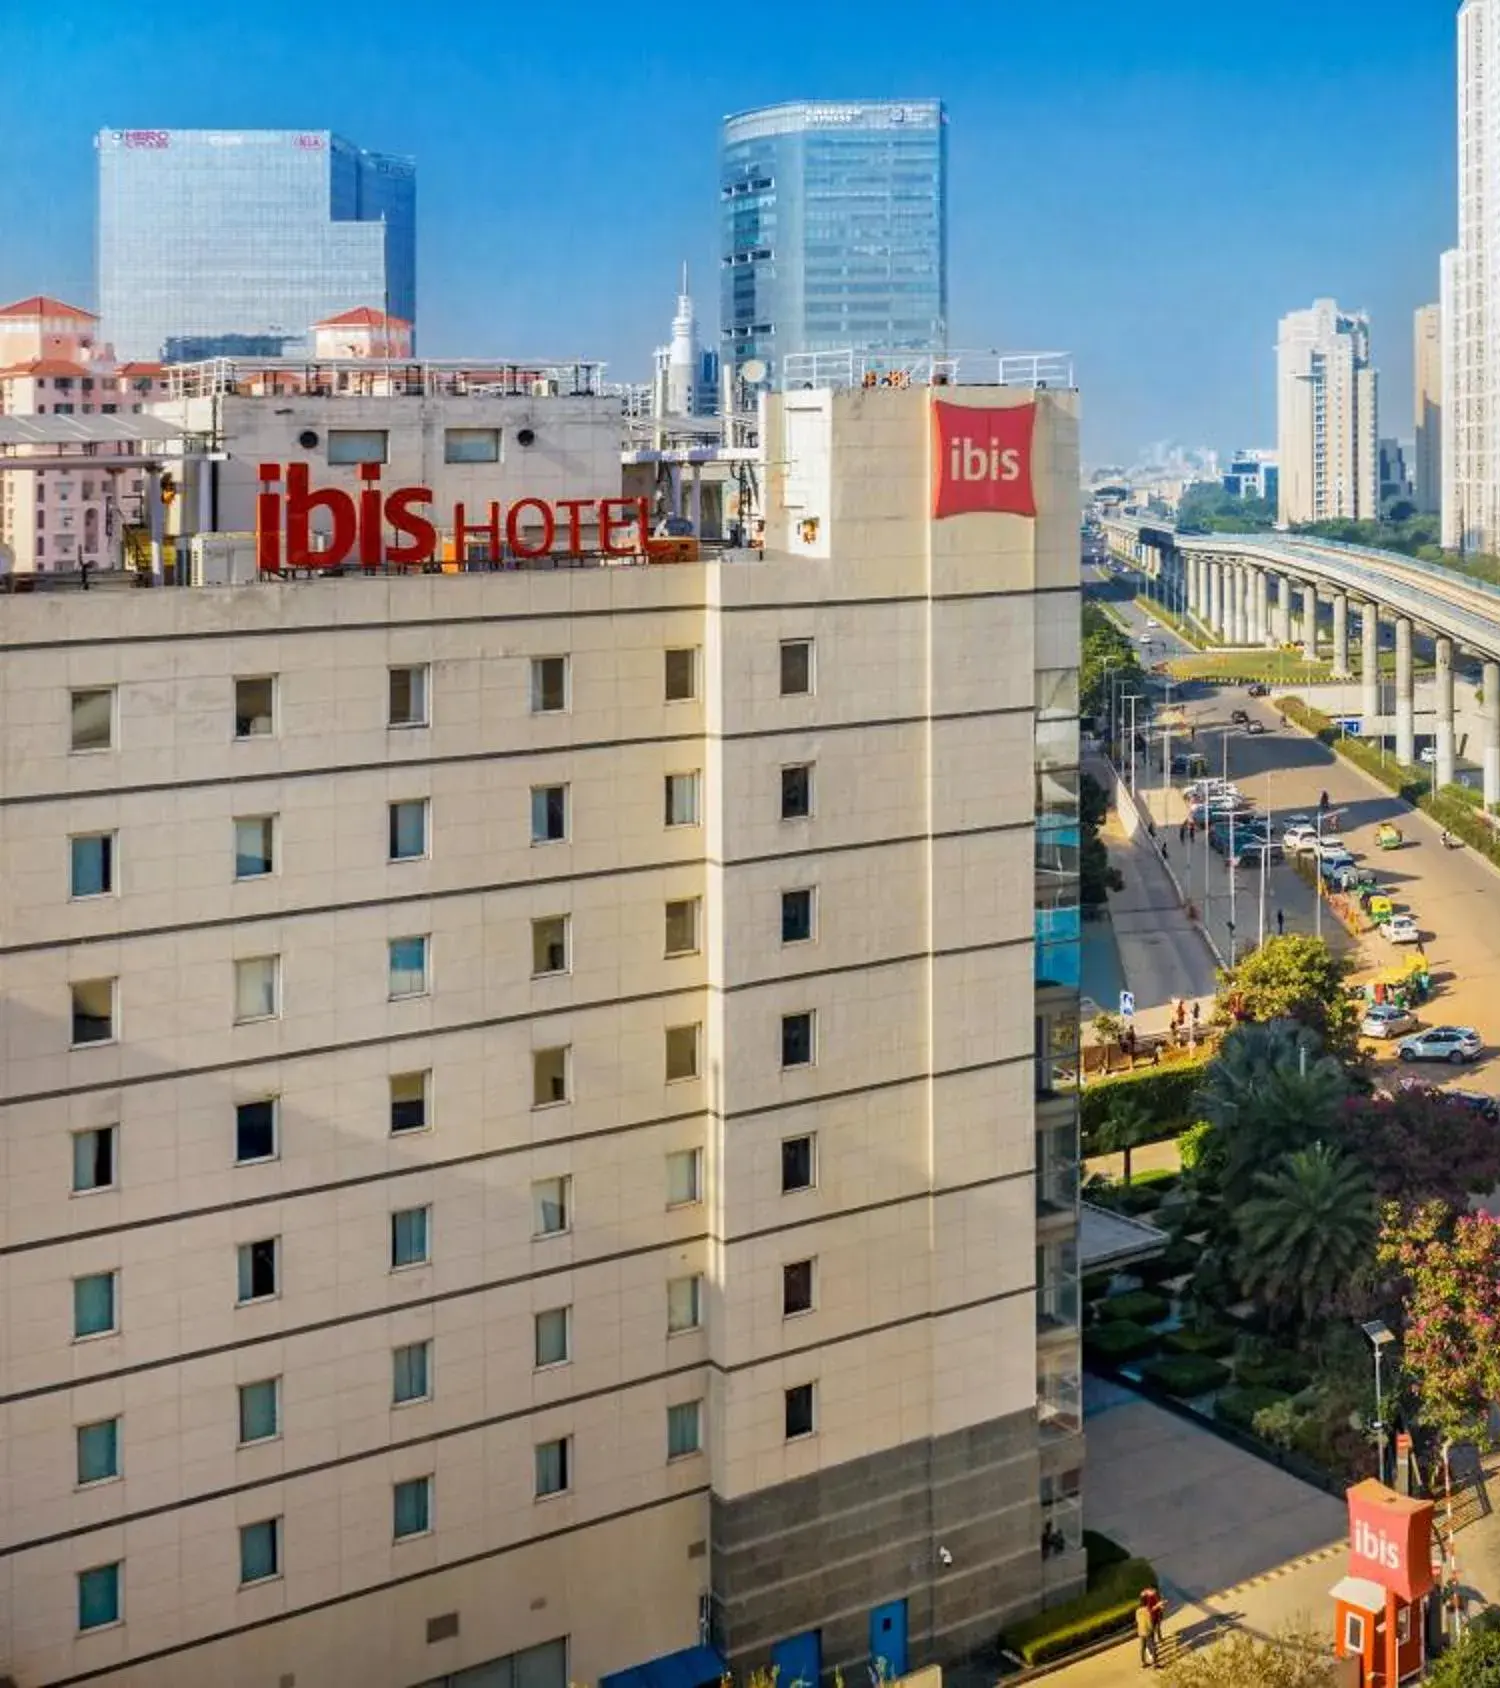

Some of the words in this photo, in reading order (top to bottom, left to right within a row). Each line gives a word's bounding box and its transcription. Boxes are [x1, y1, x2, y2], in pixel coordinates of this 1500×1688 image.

[950, 436, 1021, 482] ibis
[257, 462, 438, 573] ibis
[454, 497, 675, 563] HOTEL
[1355, 1519, 1400, 1570] ibis
